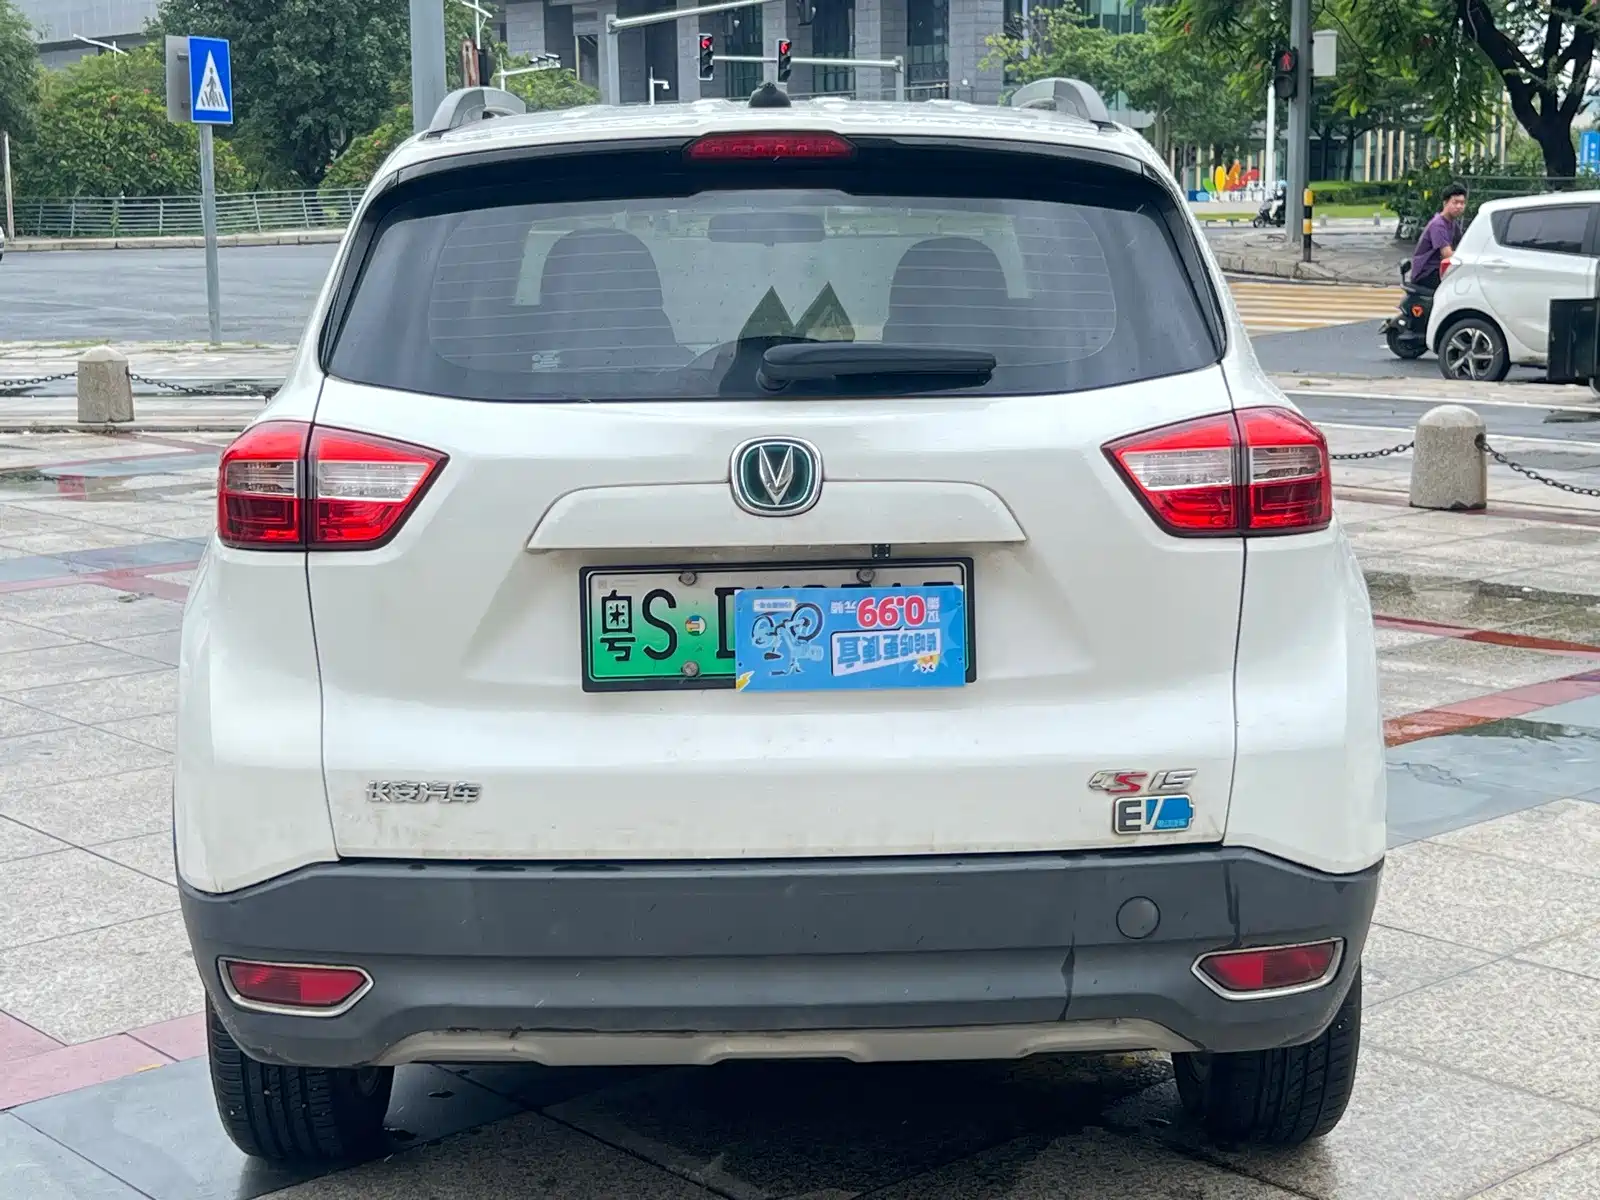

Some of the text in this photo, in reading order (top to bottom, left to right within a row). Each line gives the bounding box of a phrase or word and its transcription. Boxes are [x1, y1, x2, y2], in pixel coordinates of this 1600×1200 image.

[857, 595, 926, 627] 0.99
[365, 780, 482, 803] 长安汽车
[1115, 797, 1165, 834] EV
